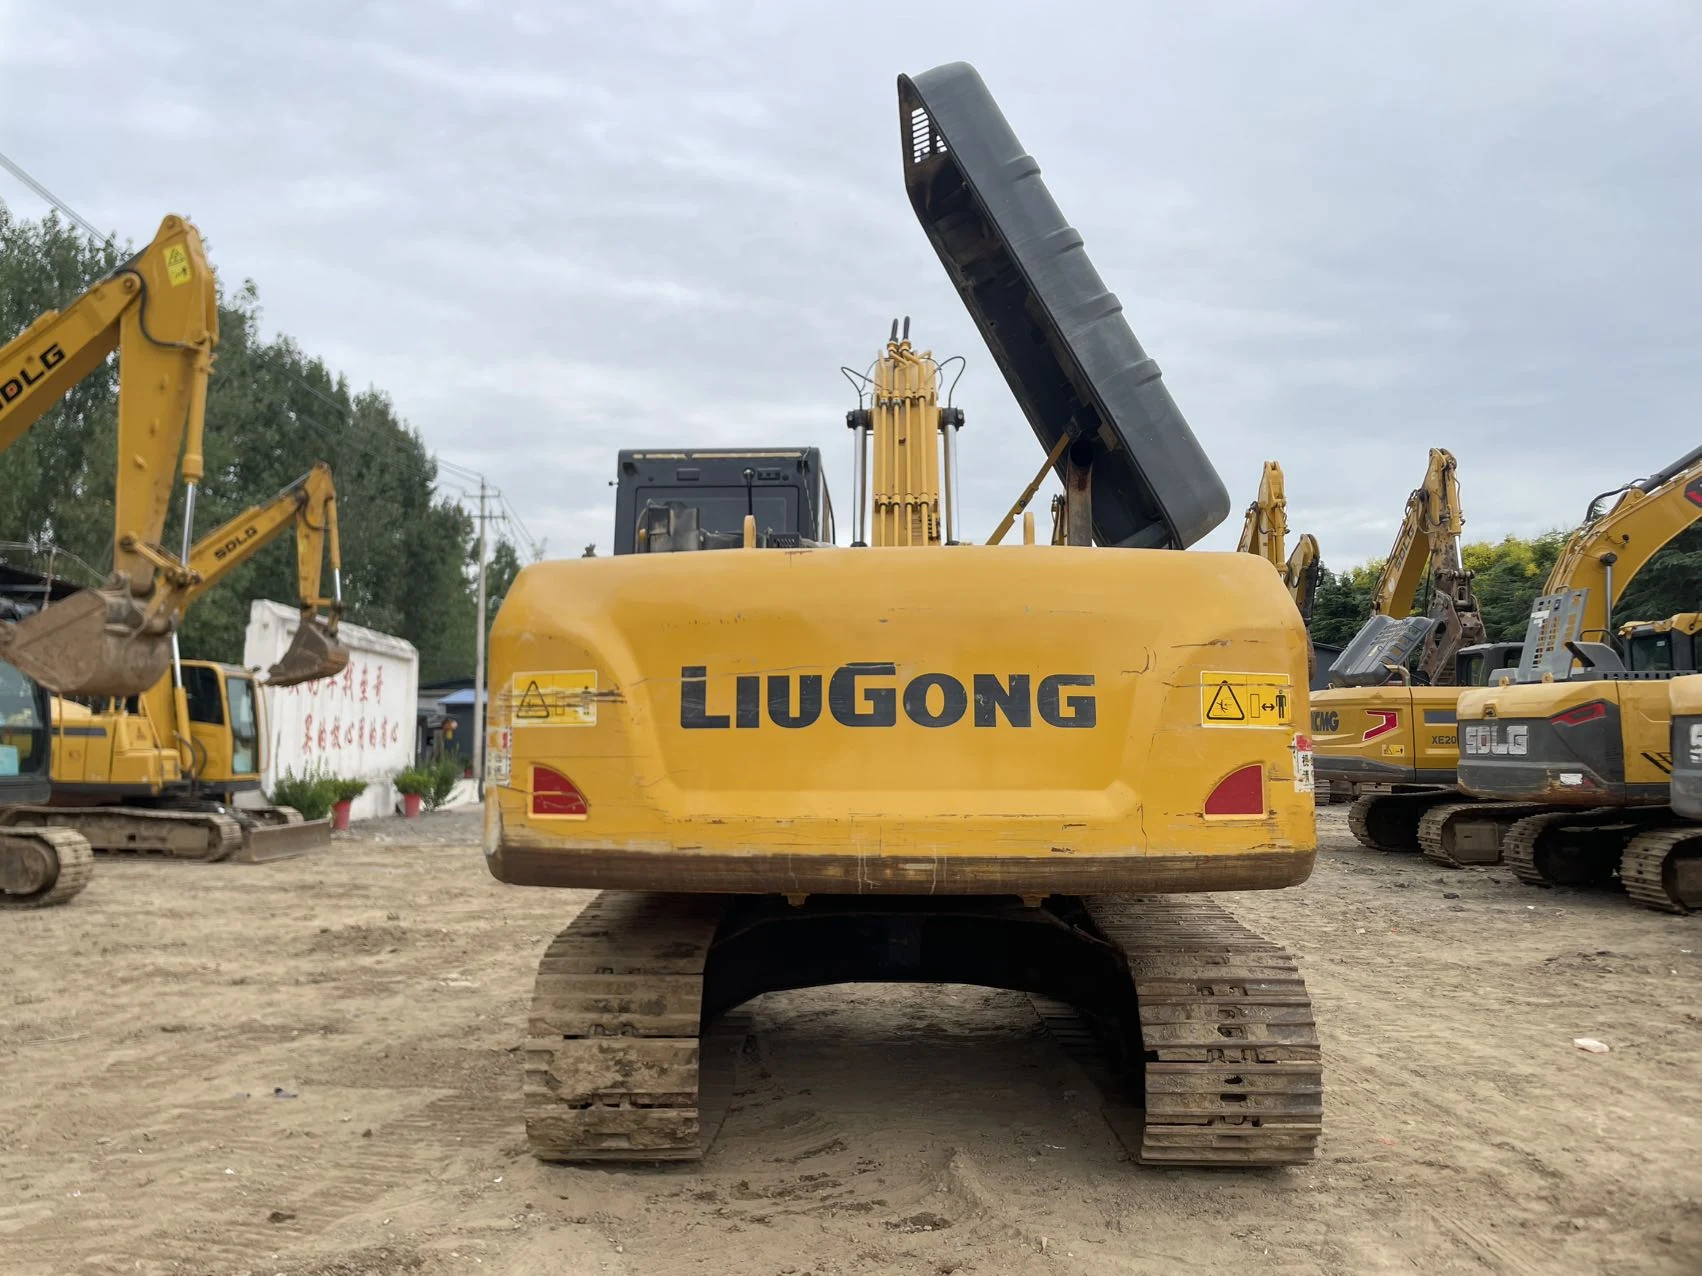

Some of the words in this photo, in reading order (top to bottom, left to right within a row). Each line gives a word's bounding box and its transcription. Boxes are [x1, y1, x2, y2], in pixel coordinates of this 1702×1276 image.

[0, 343, 66, 409] DLG
[214, 526, 257, 559] SDLG
[681, 662, 1097, 729] LIUGONG
[1465, 725, 1529, 755] SDLG
